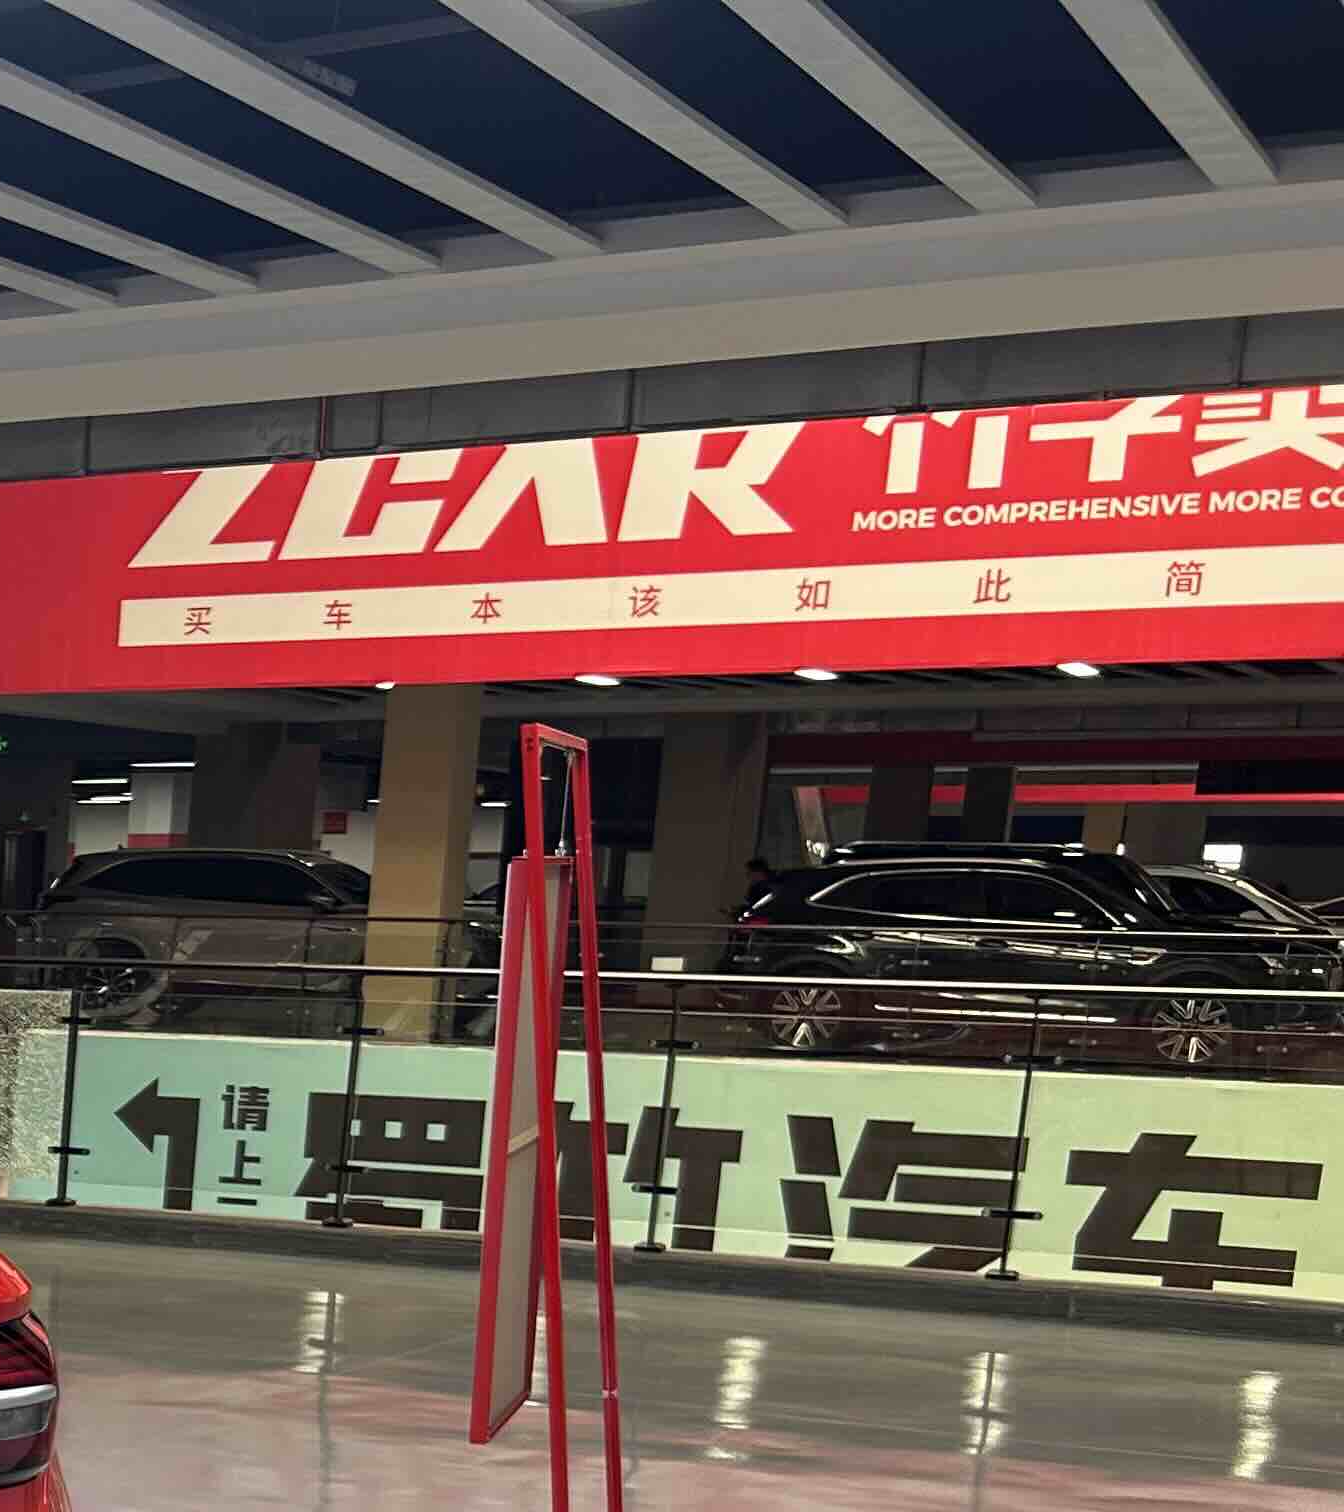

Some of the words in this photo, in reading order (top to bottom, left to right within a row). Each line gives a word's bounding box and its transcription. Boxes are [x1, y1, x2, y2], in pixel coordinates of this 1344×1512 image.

[852, 507, 936, 532] MORE
[944, 493, 1200, 527] COMPREHENSIVE
[1208, 487, 1303, 514] MORE
